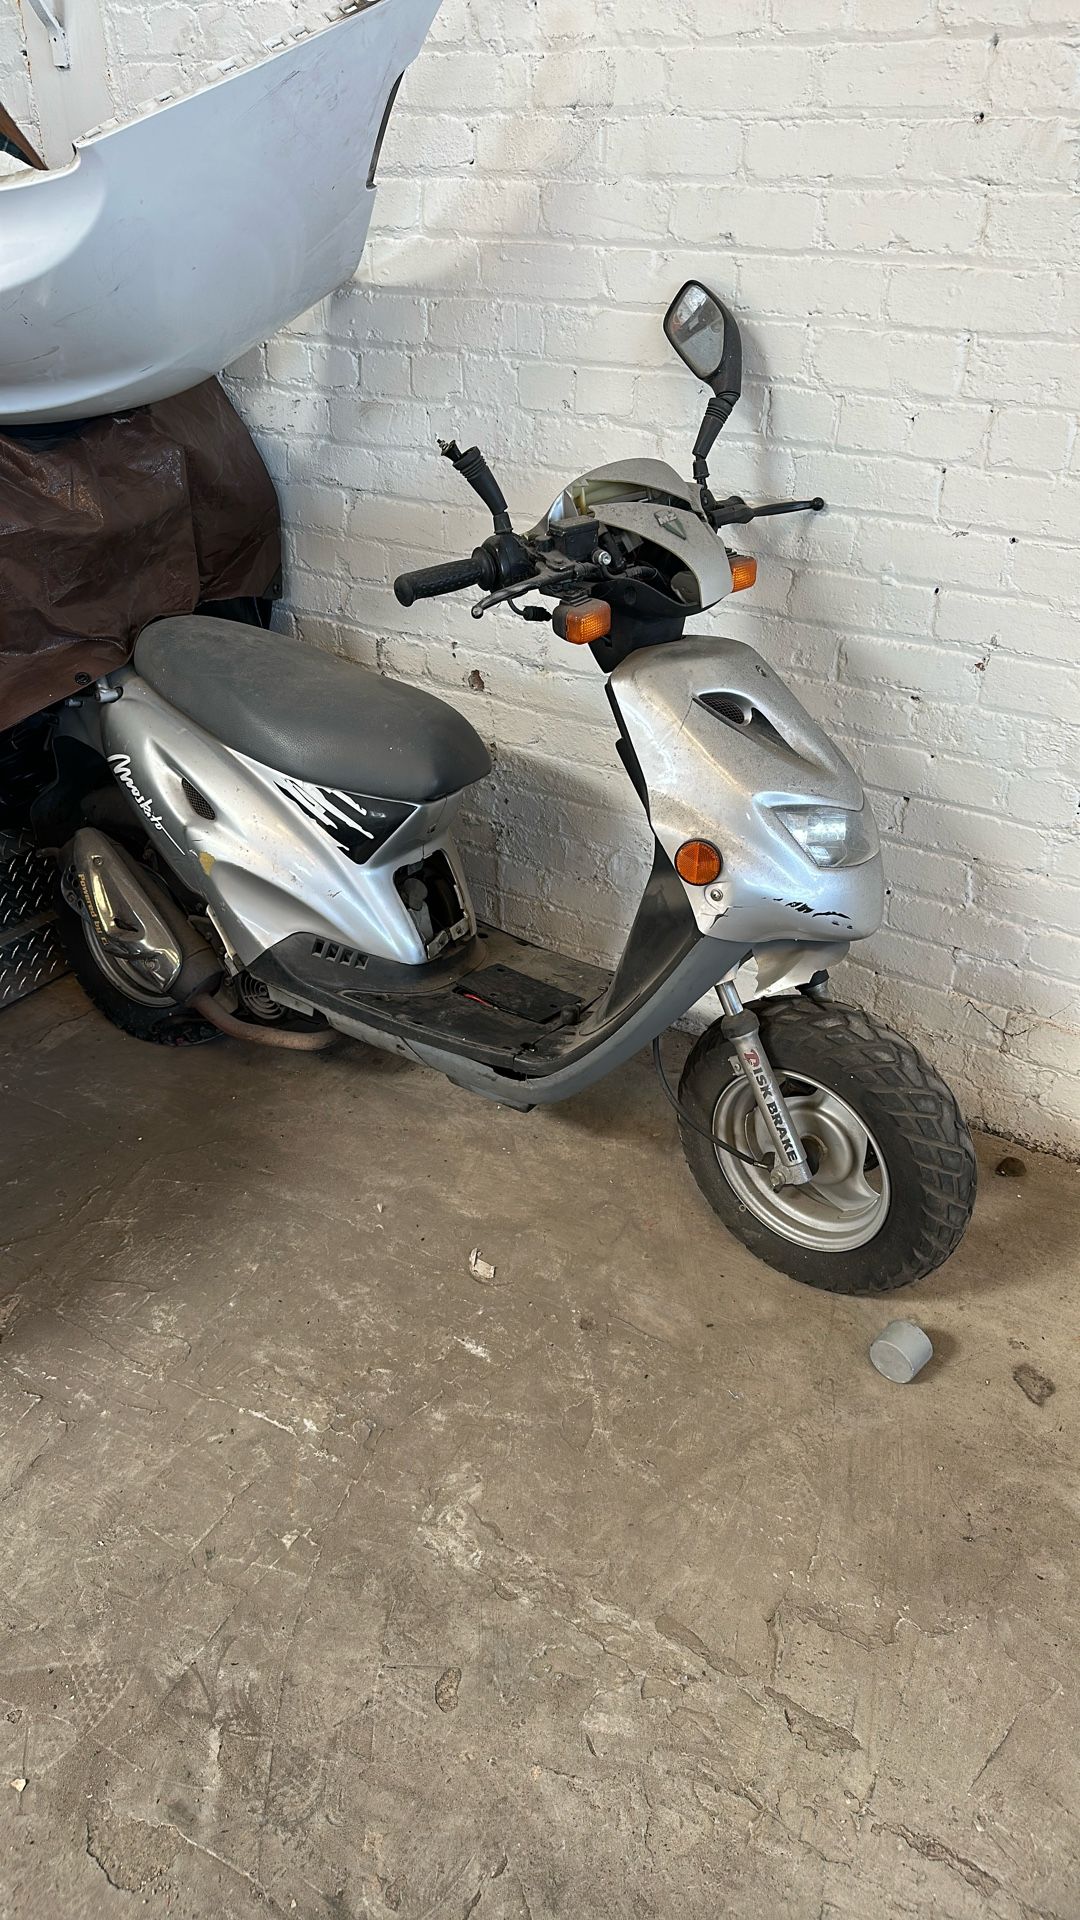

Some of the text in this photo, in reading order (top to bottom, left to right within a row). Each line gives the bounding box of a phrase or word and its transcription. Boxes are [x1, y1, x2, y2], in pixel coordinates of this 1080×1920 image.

[78, 873, 97, 918] Powered
[744, 1049, 798, 1162] DISK BRAKE
